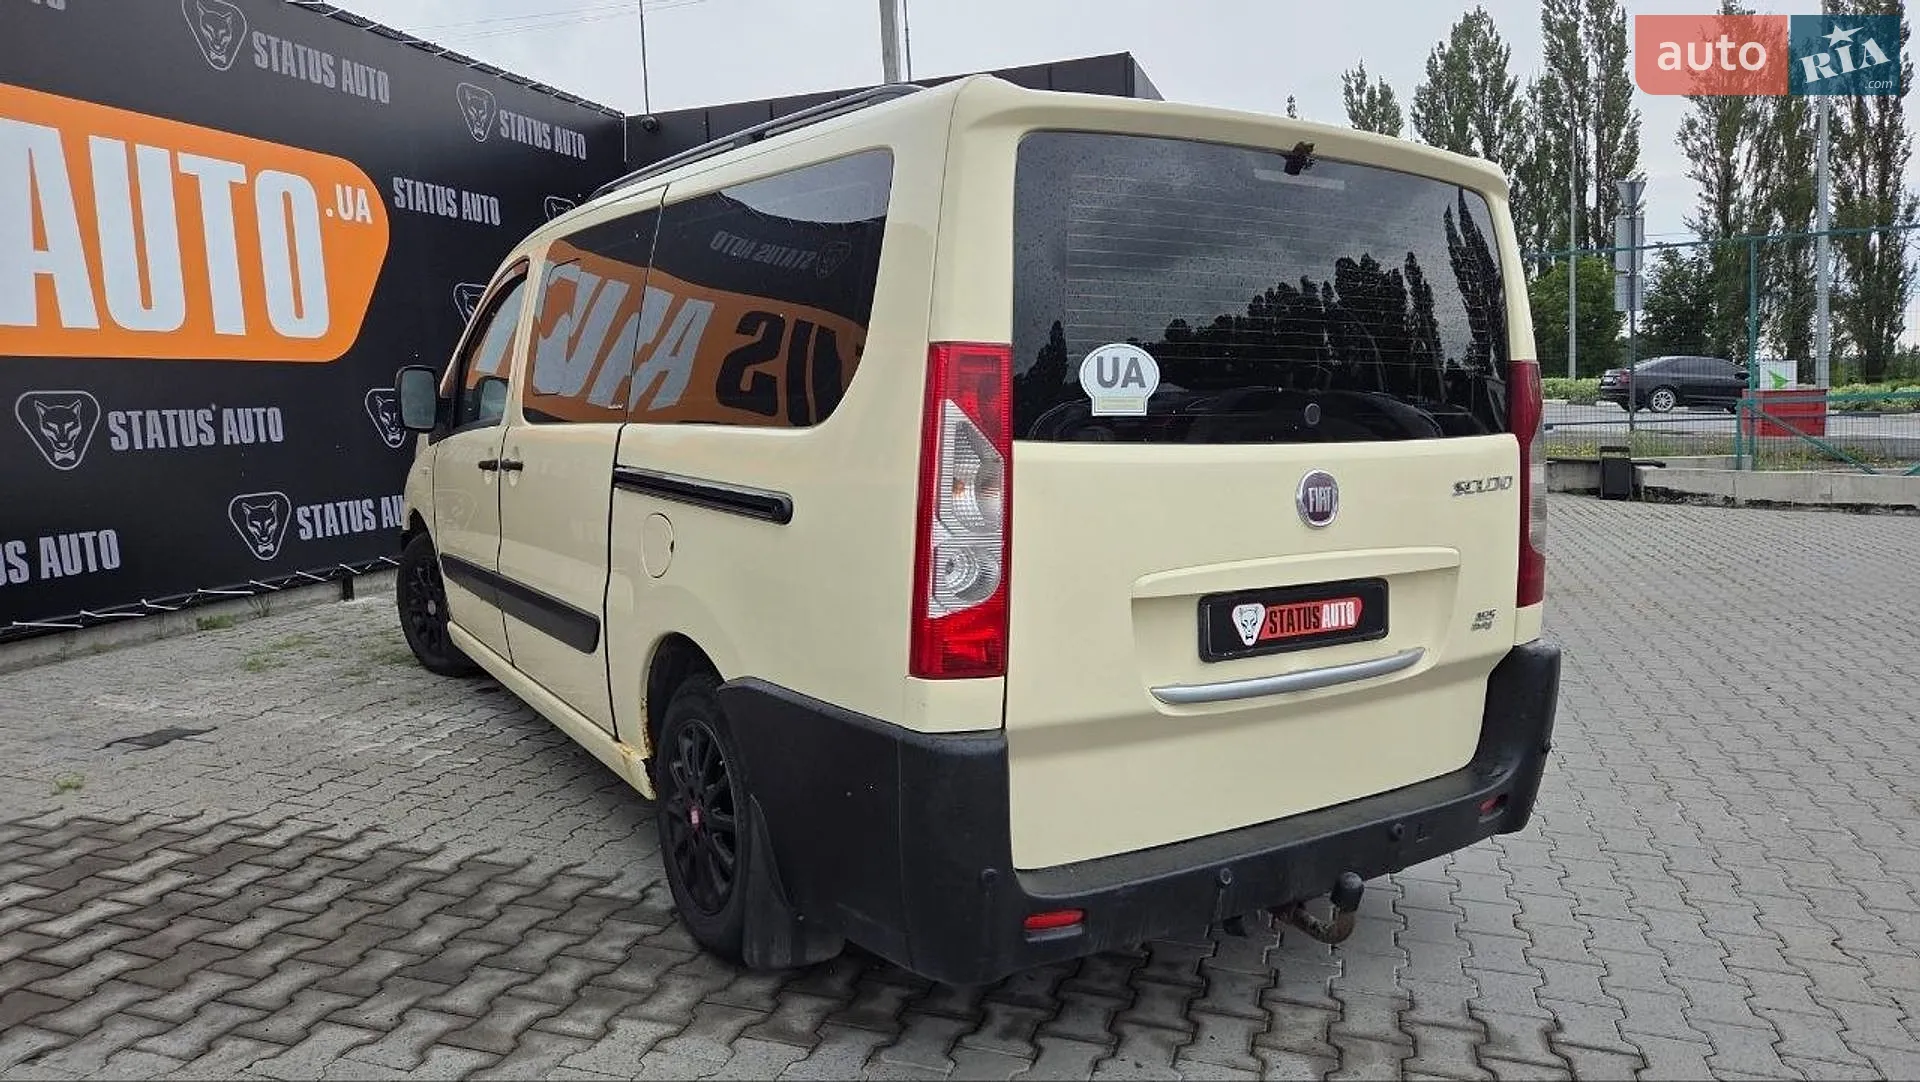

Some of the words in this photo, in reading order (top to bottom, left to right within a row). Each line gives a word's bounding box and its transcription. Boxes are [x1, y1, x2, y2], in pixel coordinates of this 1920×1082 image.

[252, 30, 336, 88] STATUS
[341, 58, 390, 104] AUTO
[499, 108, 551, 150] STATUS
[554, 126, 587, 160] AUTO
[392, 177, 457, 219] STATUS
[461, 190, 501, 226] AUTO
[1096, 355, 1146, 389] UA
[107, 408, 217, 451] STATUS
[222, 406, 284, 445] AUTO
[296, 498, 377, 540] STATUS
[1308, 486, 1332, 513] FIAT
[39, 529, 120, 579] AUTO
